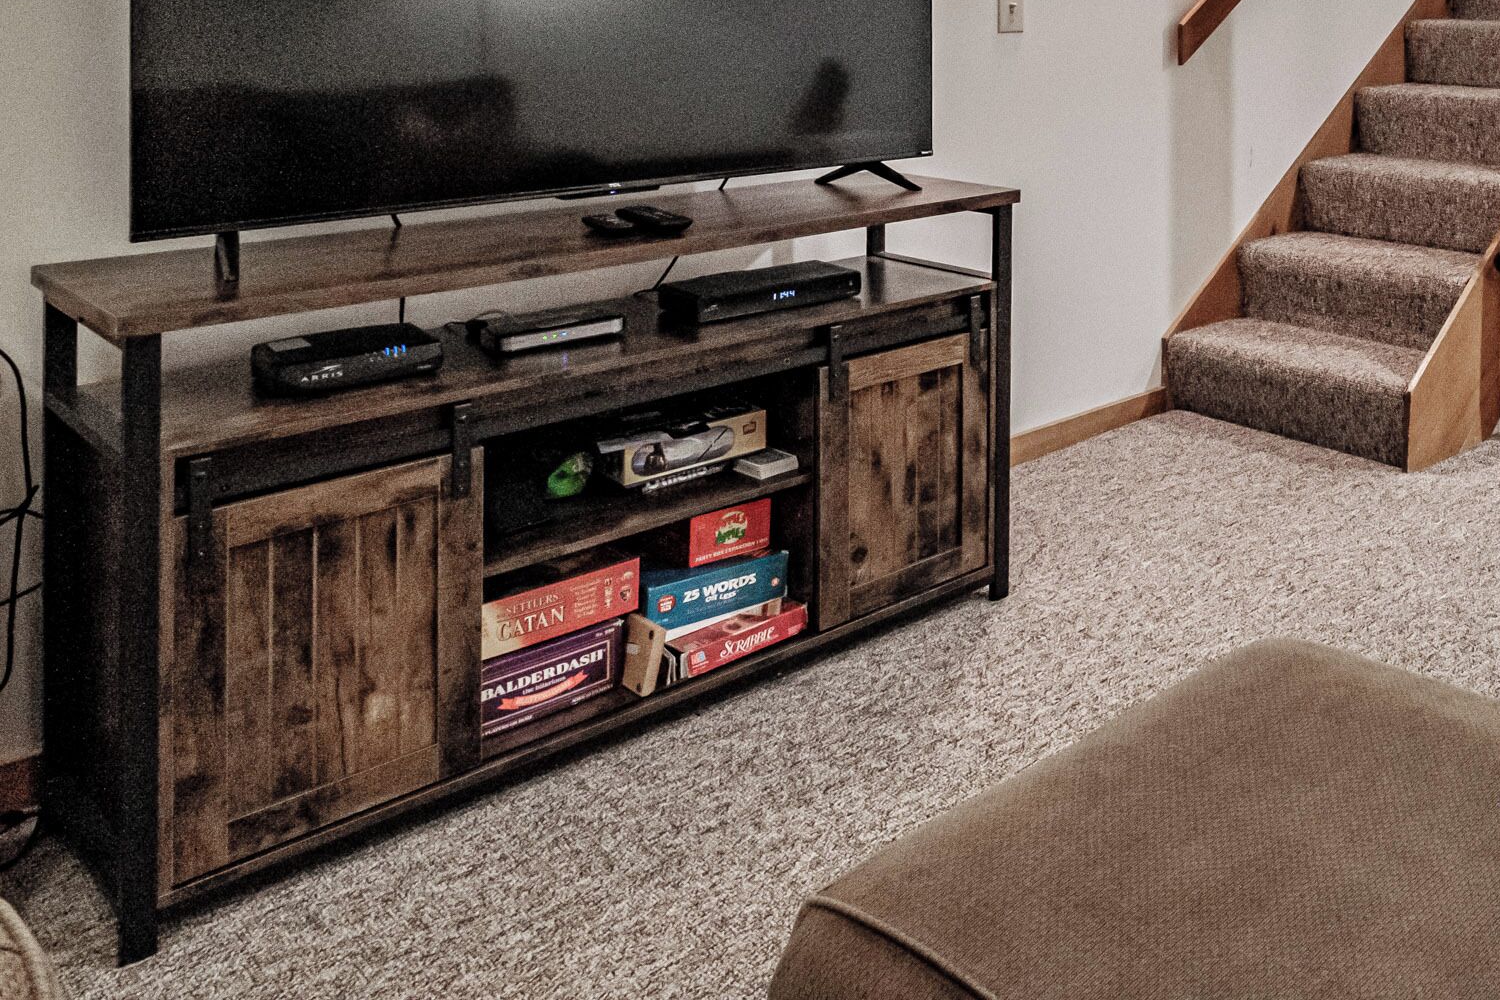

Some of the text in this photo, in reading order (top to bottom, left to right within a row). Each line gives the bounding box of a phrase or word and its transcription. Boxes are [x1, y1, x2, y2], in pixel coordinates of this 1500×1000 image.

[300, 371, 343, 382] ARRIS
[506, 594, 559, 613] SETTLERS
[682, 573, 757, 603] 25 WORDS
[496, 606, 565, 641] CATAN
[720, 626, 776, 658] SCRABBLE
[481, 649, 604, 702] BALDERDASH
